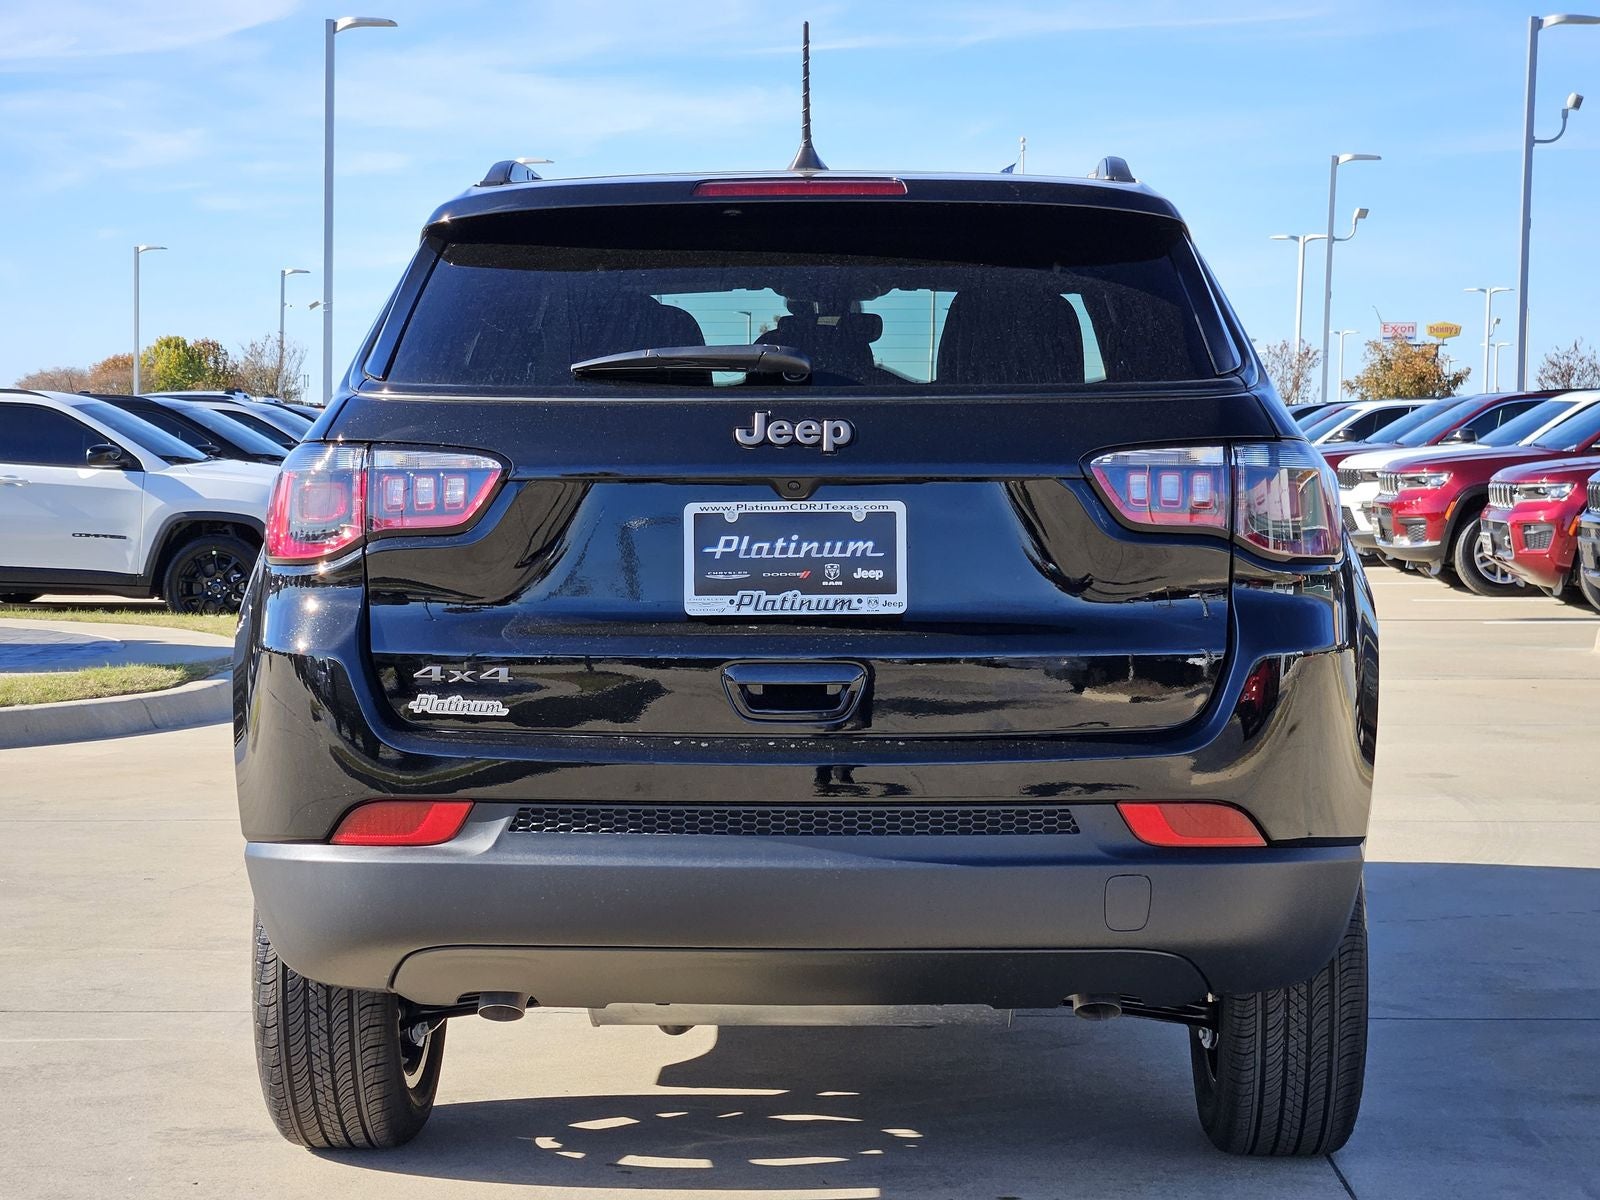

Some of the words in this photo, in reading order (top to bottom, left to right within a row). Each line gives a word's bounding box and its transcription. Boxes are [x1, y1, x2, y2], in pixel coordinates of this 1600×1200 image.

[1382, 324, 1415, 334] Exxon
[734, 411, 852, 452] Jeep
[699, 503, 889, 512] www.PlatinumCDRJTexas.com
[702, 534, 884, 559] Platinum
[853, 567, 884, 580] Jeep
[736, 593, 861, 612] Platinum
[882, 600, 904, 609] Jeep
[413, 665, 514, 683] 4x4
[408, 694, 510, 716] Platinum
